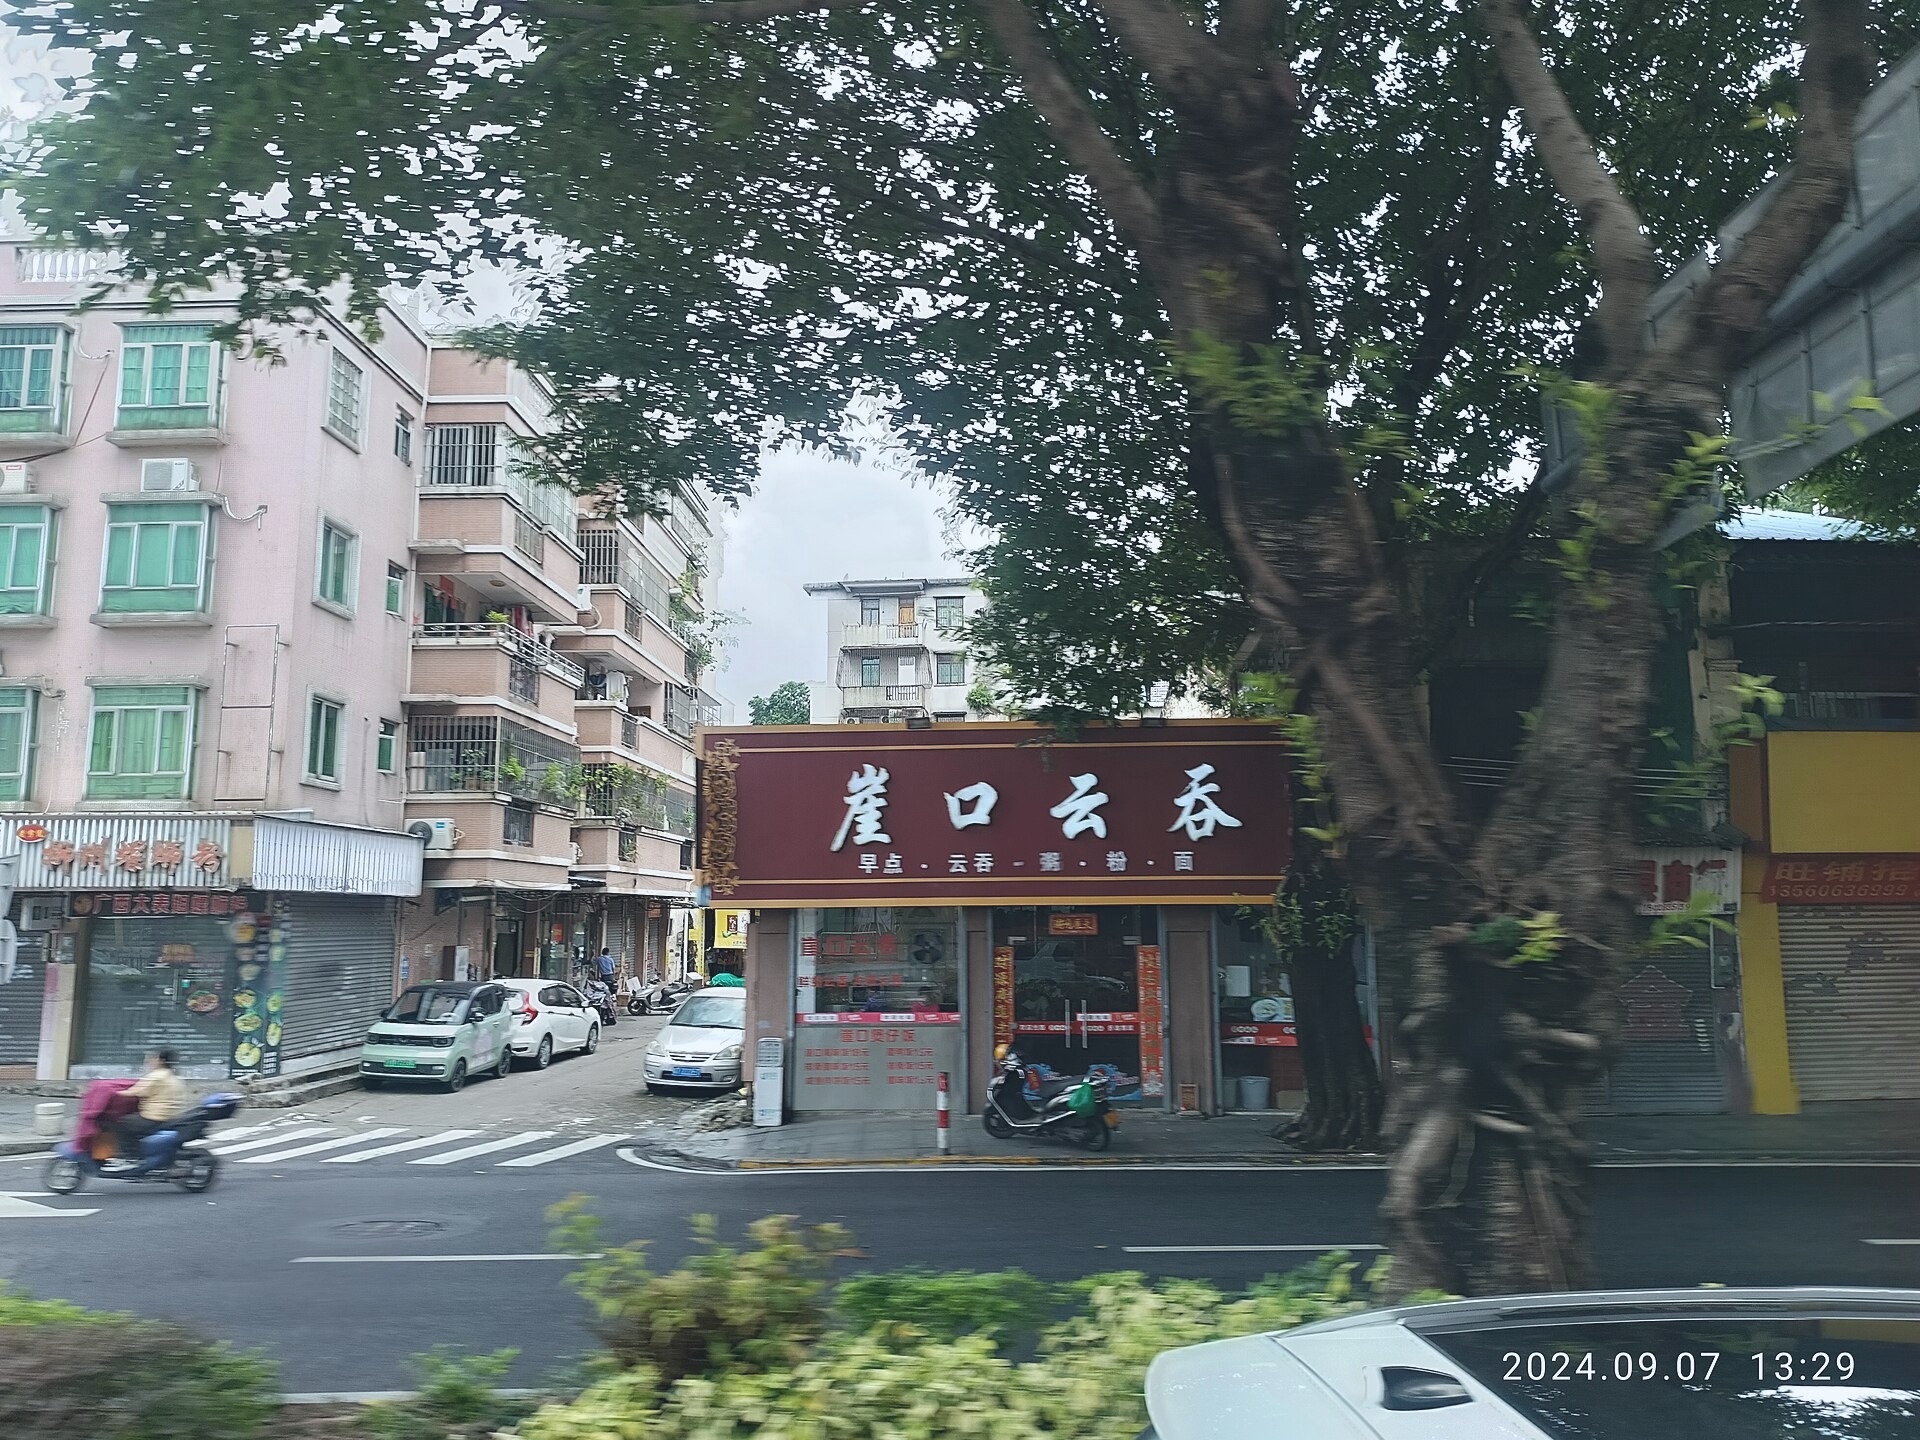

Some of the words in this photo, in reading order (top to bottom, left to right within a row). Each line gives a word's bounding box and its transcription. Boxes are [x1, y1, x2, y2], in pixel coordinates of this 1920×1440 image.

[829, 763, 1244, 853] 崖口云吞
[857, 853, 903, 874] 早点
[947, 852, 994, 873] 云吞
[1105, 851, 1127, 871] 粉
[1173, 851, 1194, 871] 面
